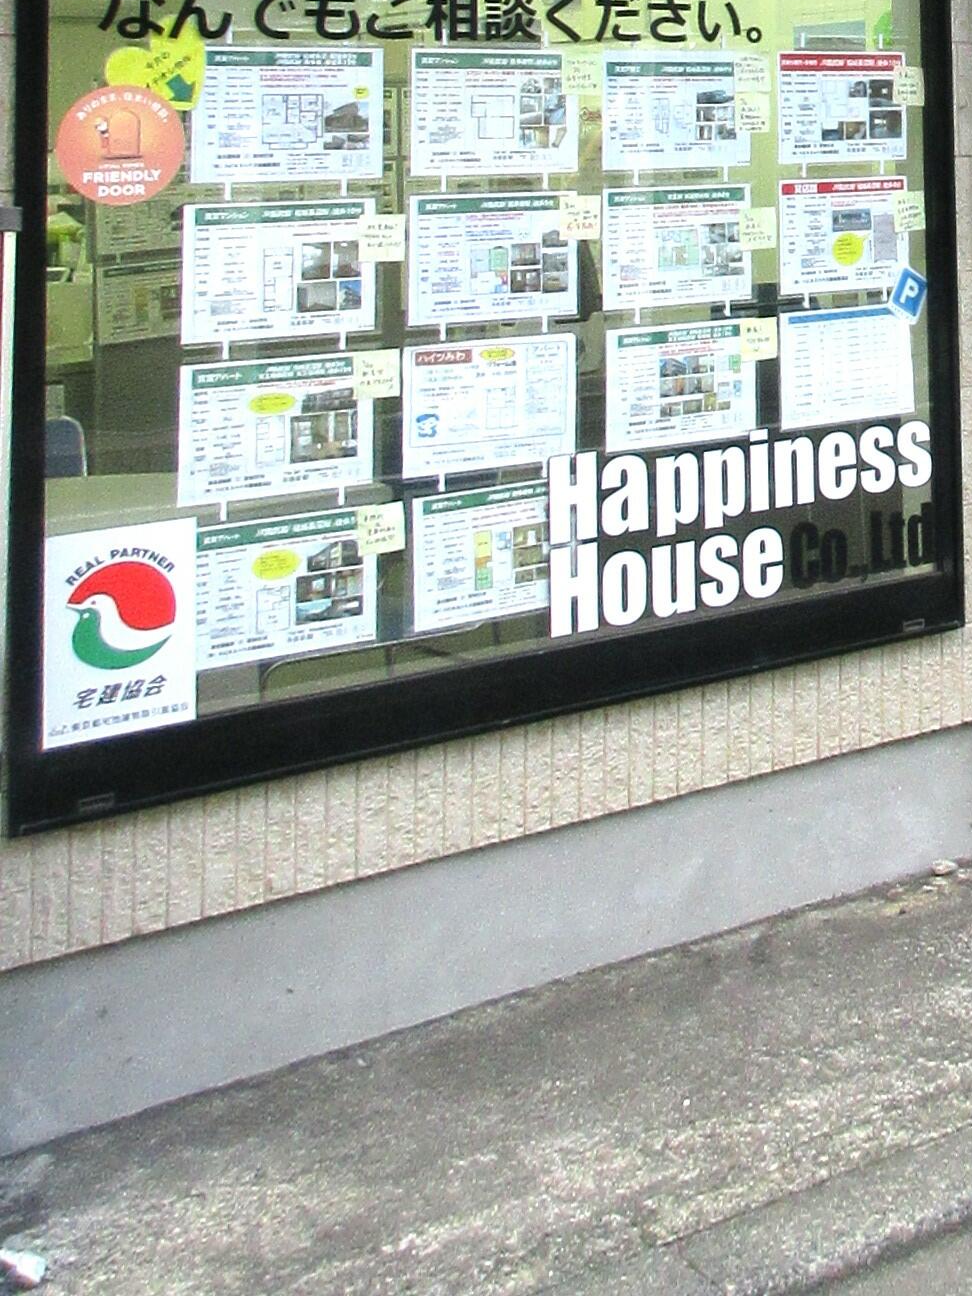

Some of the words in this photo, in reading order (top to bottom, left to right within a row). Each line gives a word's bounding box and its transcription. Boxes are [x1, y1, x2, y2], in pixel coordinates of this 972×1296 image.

[82, 167, 162, 185] FRIENDLY
[96, 184, 146, 198] DOOR
[899, 276, 920, 305] P
[547, 419, 934, 545] Happiness
[65, 556, 106, 587] REAL
[110, 547, 176, 574] PARTNER
[548, 526, 786, 639] House
[73, 674, 168, 710] 宅建協会
